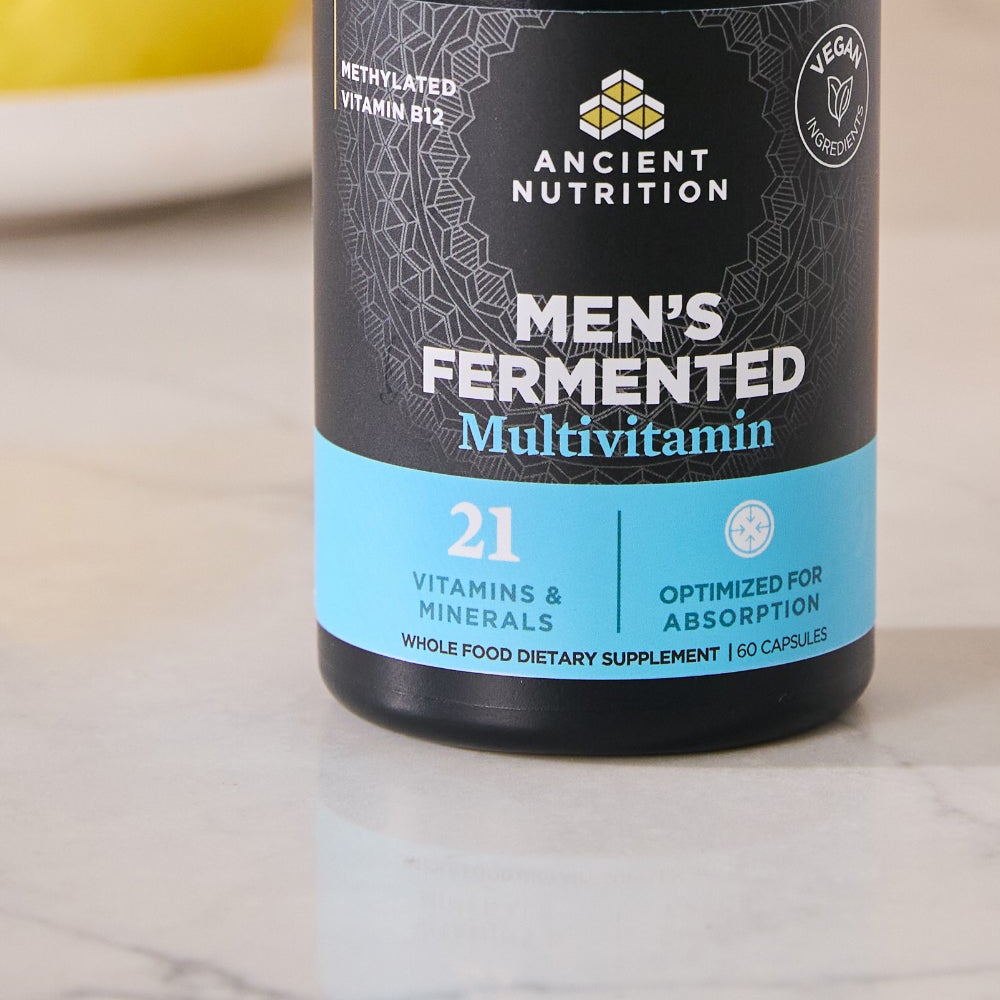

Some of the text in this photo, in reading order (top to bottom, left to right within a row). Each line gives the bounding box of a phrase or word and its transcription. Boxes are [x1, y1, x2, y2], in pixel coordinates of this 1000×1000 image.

[810, 35, 862, 76] VEGAN
[341, 59, 457, 98] METHYLATED
[341, 90, 444, 126] VITAMIN B12
[806, 104, 864, 156] INGREDIENTS
[533, 148, 709, 174] ANCIENT
[512, 177, 729, 205] NUTRITION
[516, 291, 724, 344] MEN'S
[422, 345, 806, 406] FERMENTED
[458, 408, 774, 458] Multivitamin
[447, 501, 521, 562] 21
[412, 571, 562, 605] VITAMINS &
[659, 566, 823, 605] OPTIMIZED FOR
[419, 599, 554, 633] MINERALS
[663, 593, 820, 633] ABSORPTION
[401, 627, 828, 667] WHOLE FOOD DIETARY SUPPLEMENT 60 CAPSULES
